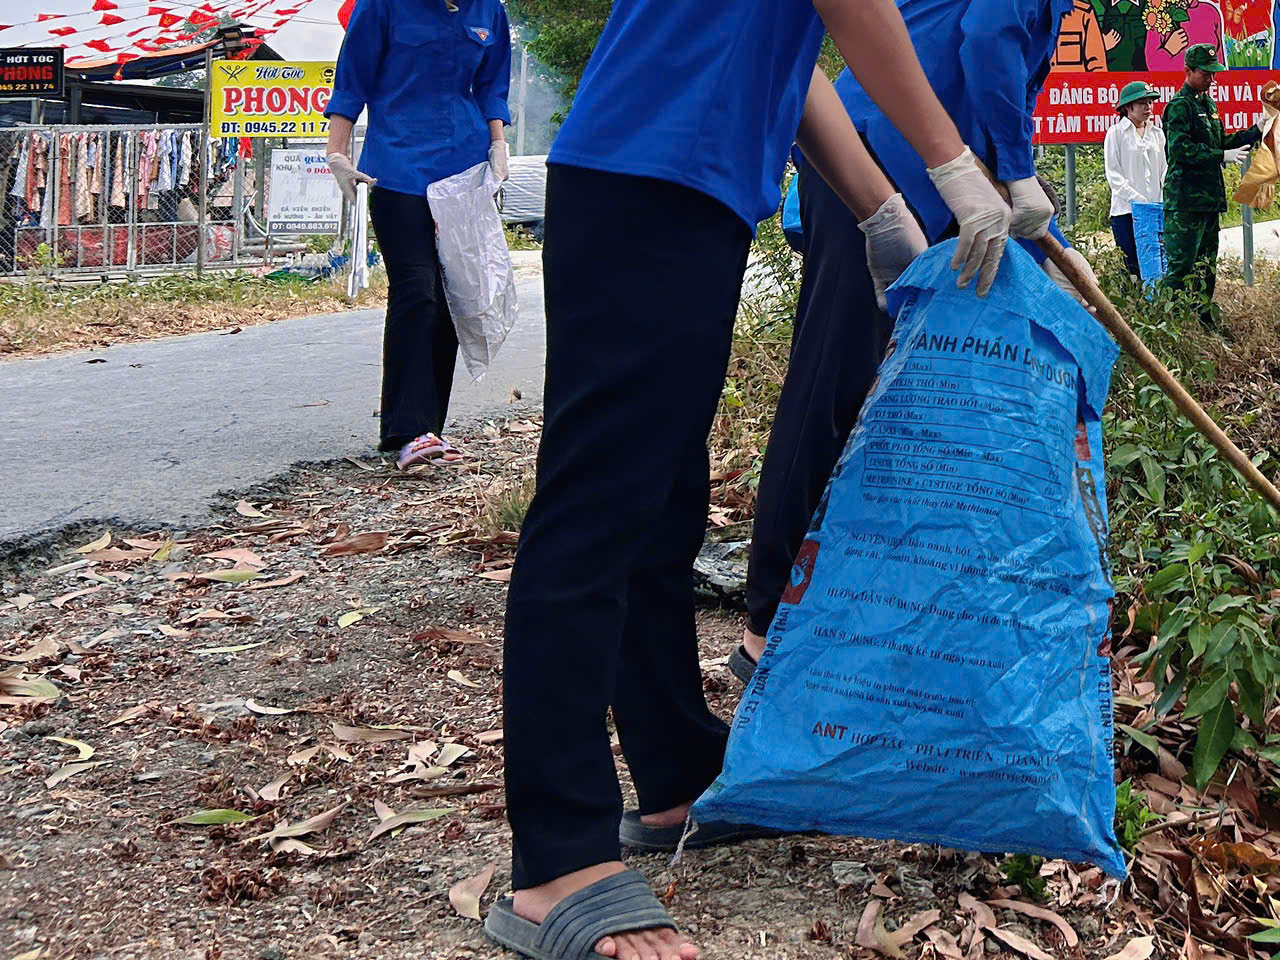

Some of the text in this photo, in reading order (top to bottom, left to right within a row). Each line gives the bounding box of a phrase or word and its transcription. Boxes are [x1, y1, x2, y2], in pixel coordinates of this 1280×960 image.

[223, 87, 332, 113] PHONG
[1049, 82, 1093, 105] ĐẢNG
[1097, 84, 1119, 110] BỘ
[1233, 80, 1254, 101] VÀ
[221, 122, 240, 133] ĐT:
[244, 122, 297, 134] 0945.22
[301, 122, 314, 133] 11
[1046, 113, 1081, 134] TÂM
[744, 700, 760, 714] 21
[812, 721, 849, 741] ANT
